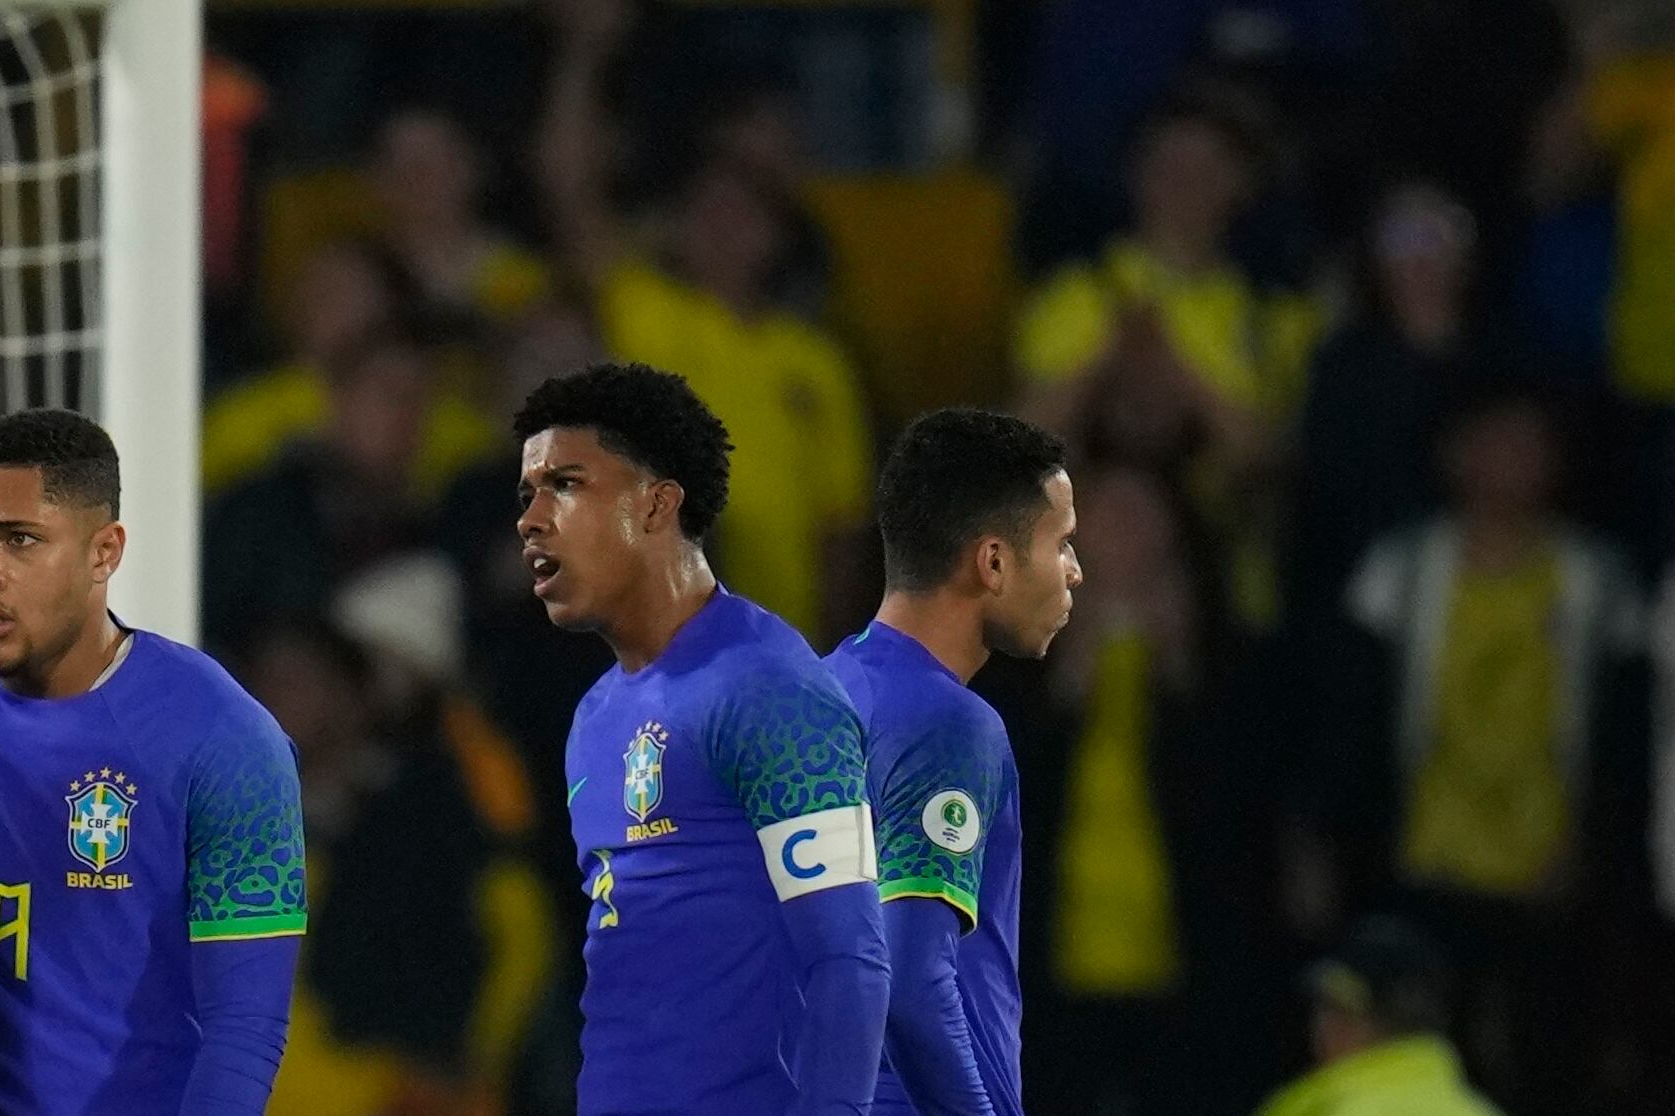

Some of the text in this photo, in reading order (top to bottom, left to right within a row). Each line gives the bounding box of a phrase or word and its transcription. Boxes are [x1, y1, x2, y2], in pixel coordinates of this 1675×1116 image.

[87, 818, 111, 829] CBF
[626, 818, 678, 842] BRASIL
[781, 829, 826, 879] C
[66, 871, 133, 889] BRASIL
